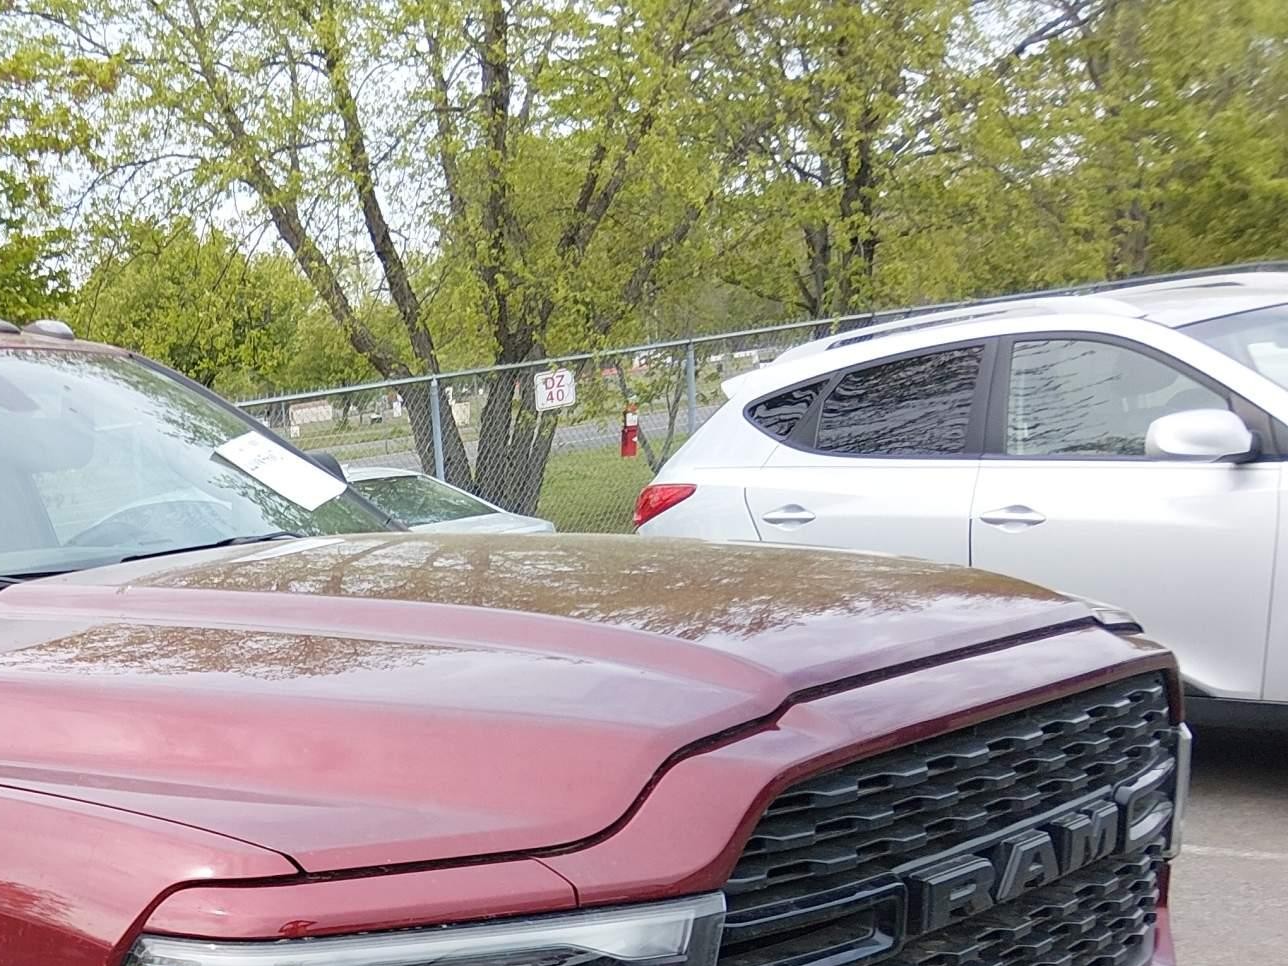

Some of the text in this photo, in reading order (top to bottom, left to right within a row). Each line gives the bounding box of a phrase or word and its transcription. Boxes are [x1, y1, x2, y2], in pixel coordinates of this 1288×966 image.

[543, 374, 566, 391] DZ
[546, 389, 565, 402] 40
[909, 799, 1119, 934] RAM
